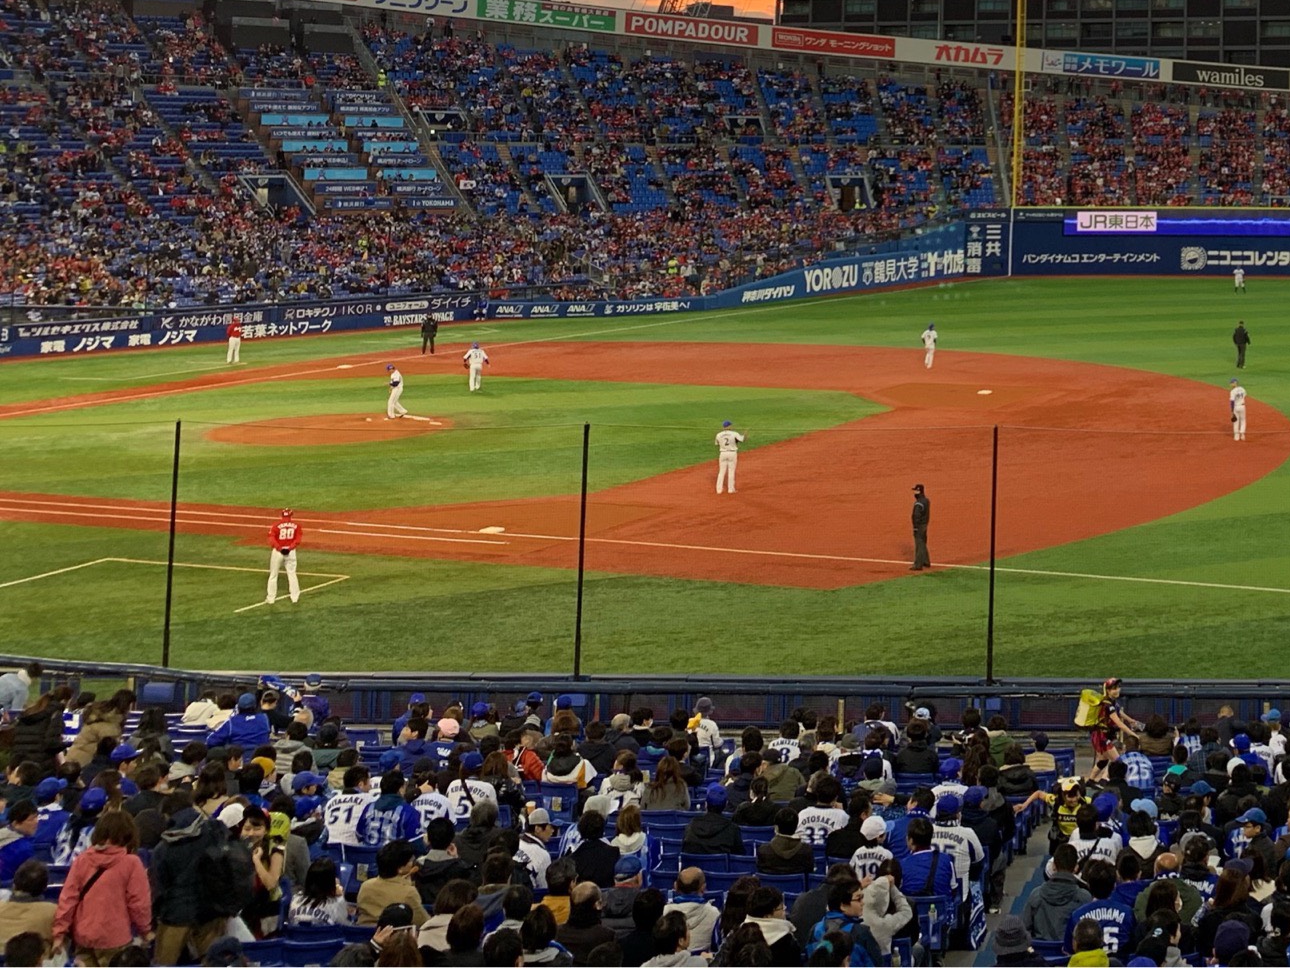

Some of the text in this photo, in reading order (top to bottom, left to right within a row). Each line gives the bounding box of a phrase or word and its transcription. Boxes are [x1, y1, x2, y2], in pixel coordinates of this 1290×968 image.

[631, 15, 749, 43] POMPADOUR
[805, 37, 891, 51] ワンダ モーニングショット
[1078, 57, 1159, 78] メモワール
[1196, 68, 1264, 87] wamiles
[422, 199, 454, 207] YOKOHAMA
[1080, 214, 1155, 230] JR東日本
[1022, 253, 1161, 264] バンダイナムコ エンターテインメント
[873, 256, 919, 284] 鶴見大学
[431, 297, 472, 310] ダイイチ
[496, 305, 515, 314] ANA
[531, 305, 550, 314] ANA
[567, 304, 586, 313] ANA
[179, 311, 263, 327] かながわ信用金庫
[297, 307, 337, 319] ロキテクノ
[240, 320, 332, 340] 若葉ネットワーク
[40, 329, 198, 354] 家電 ノジマ 家電 ノジマ
[279, 528, 295, 540] 80
[780, 748, 790, 764] 8
[1129, 764, 1150, 780] 25
[456, 796, 470, 816] 5
[329, 806, 353, 825] 51
[801, 815, 836, 828] OTOSAKA
[859, 862, 880, 880] 19
[1103, 926, 1119, 954] 5
